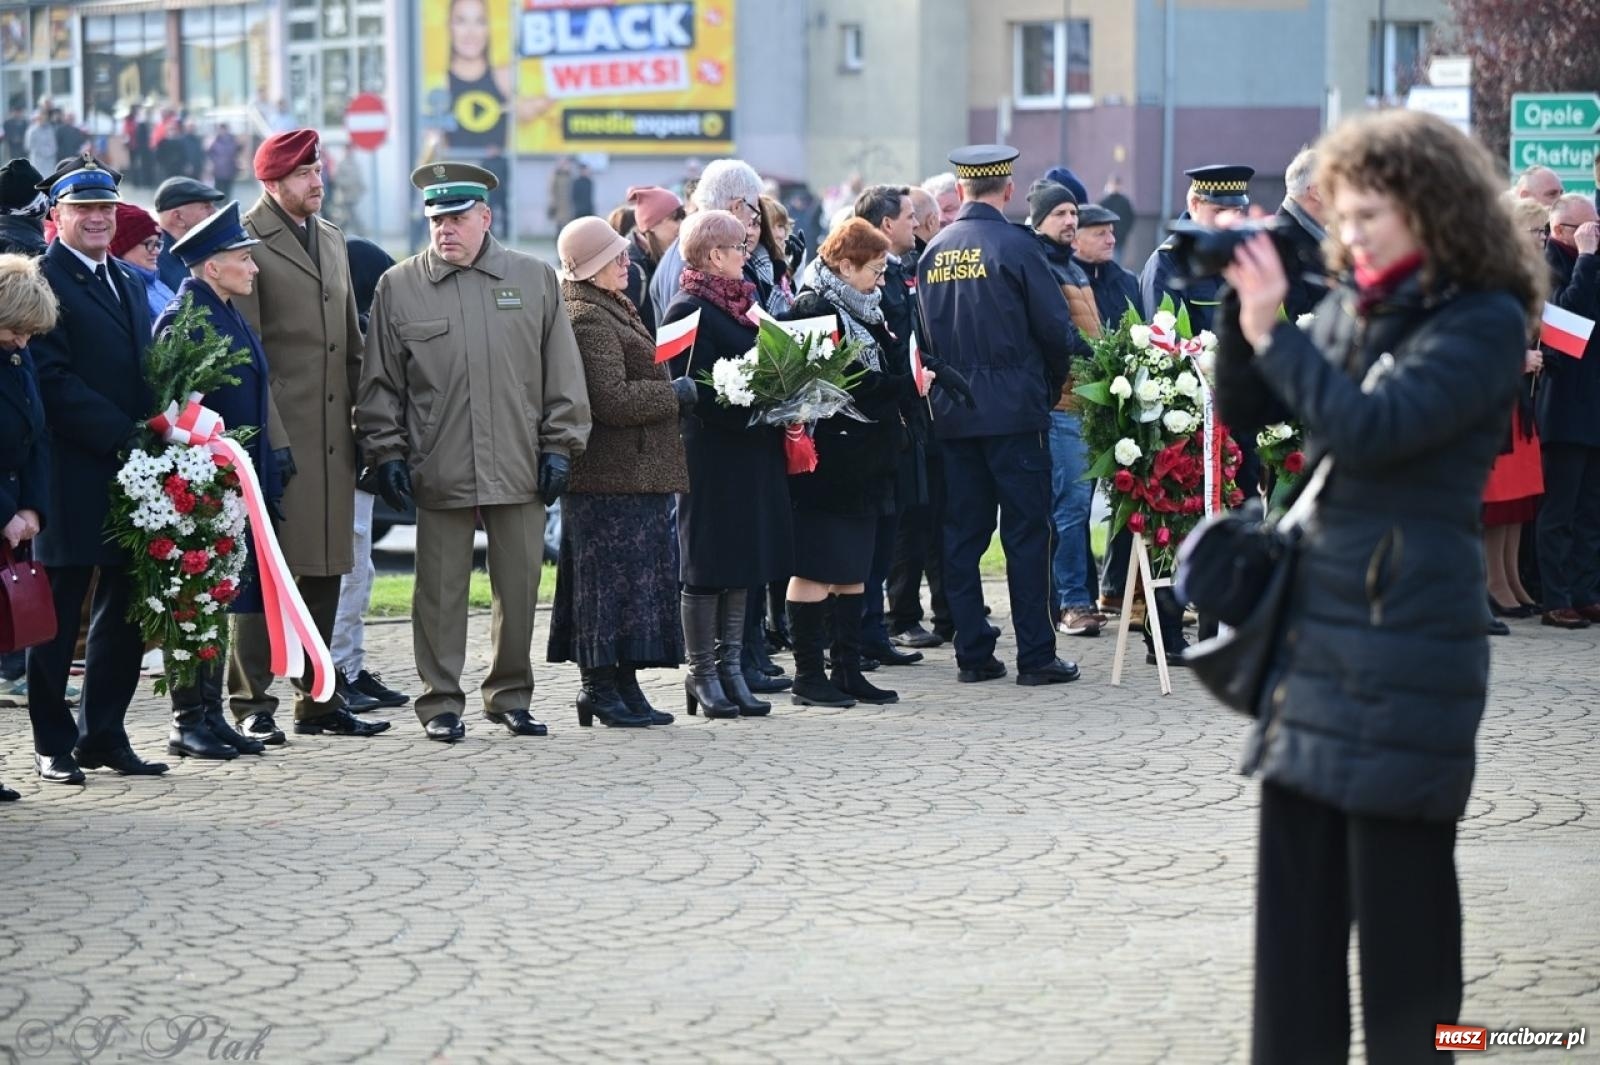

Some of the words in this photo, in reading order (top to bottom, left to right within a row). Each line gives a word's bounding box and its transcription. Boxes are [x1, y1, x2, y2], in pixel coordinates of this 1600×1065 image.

[523, 4, 691, 55] BLACK
[553, 59, 680, 90] WEEKS!
[1524, 102, 1584, 129] Opole
[927, 264, 987, 284] MIEJSKA
